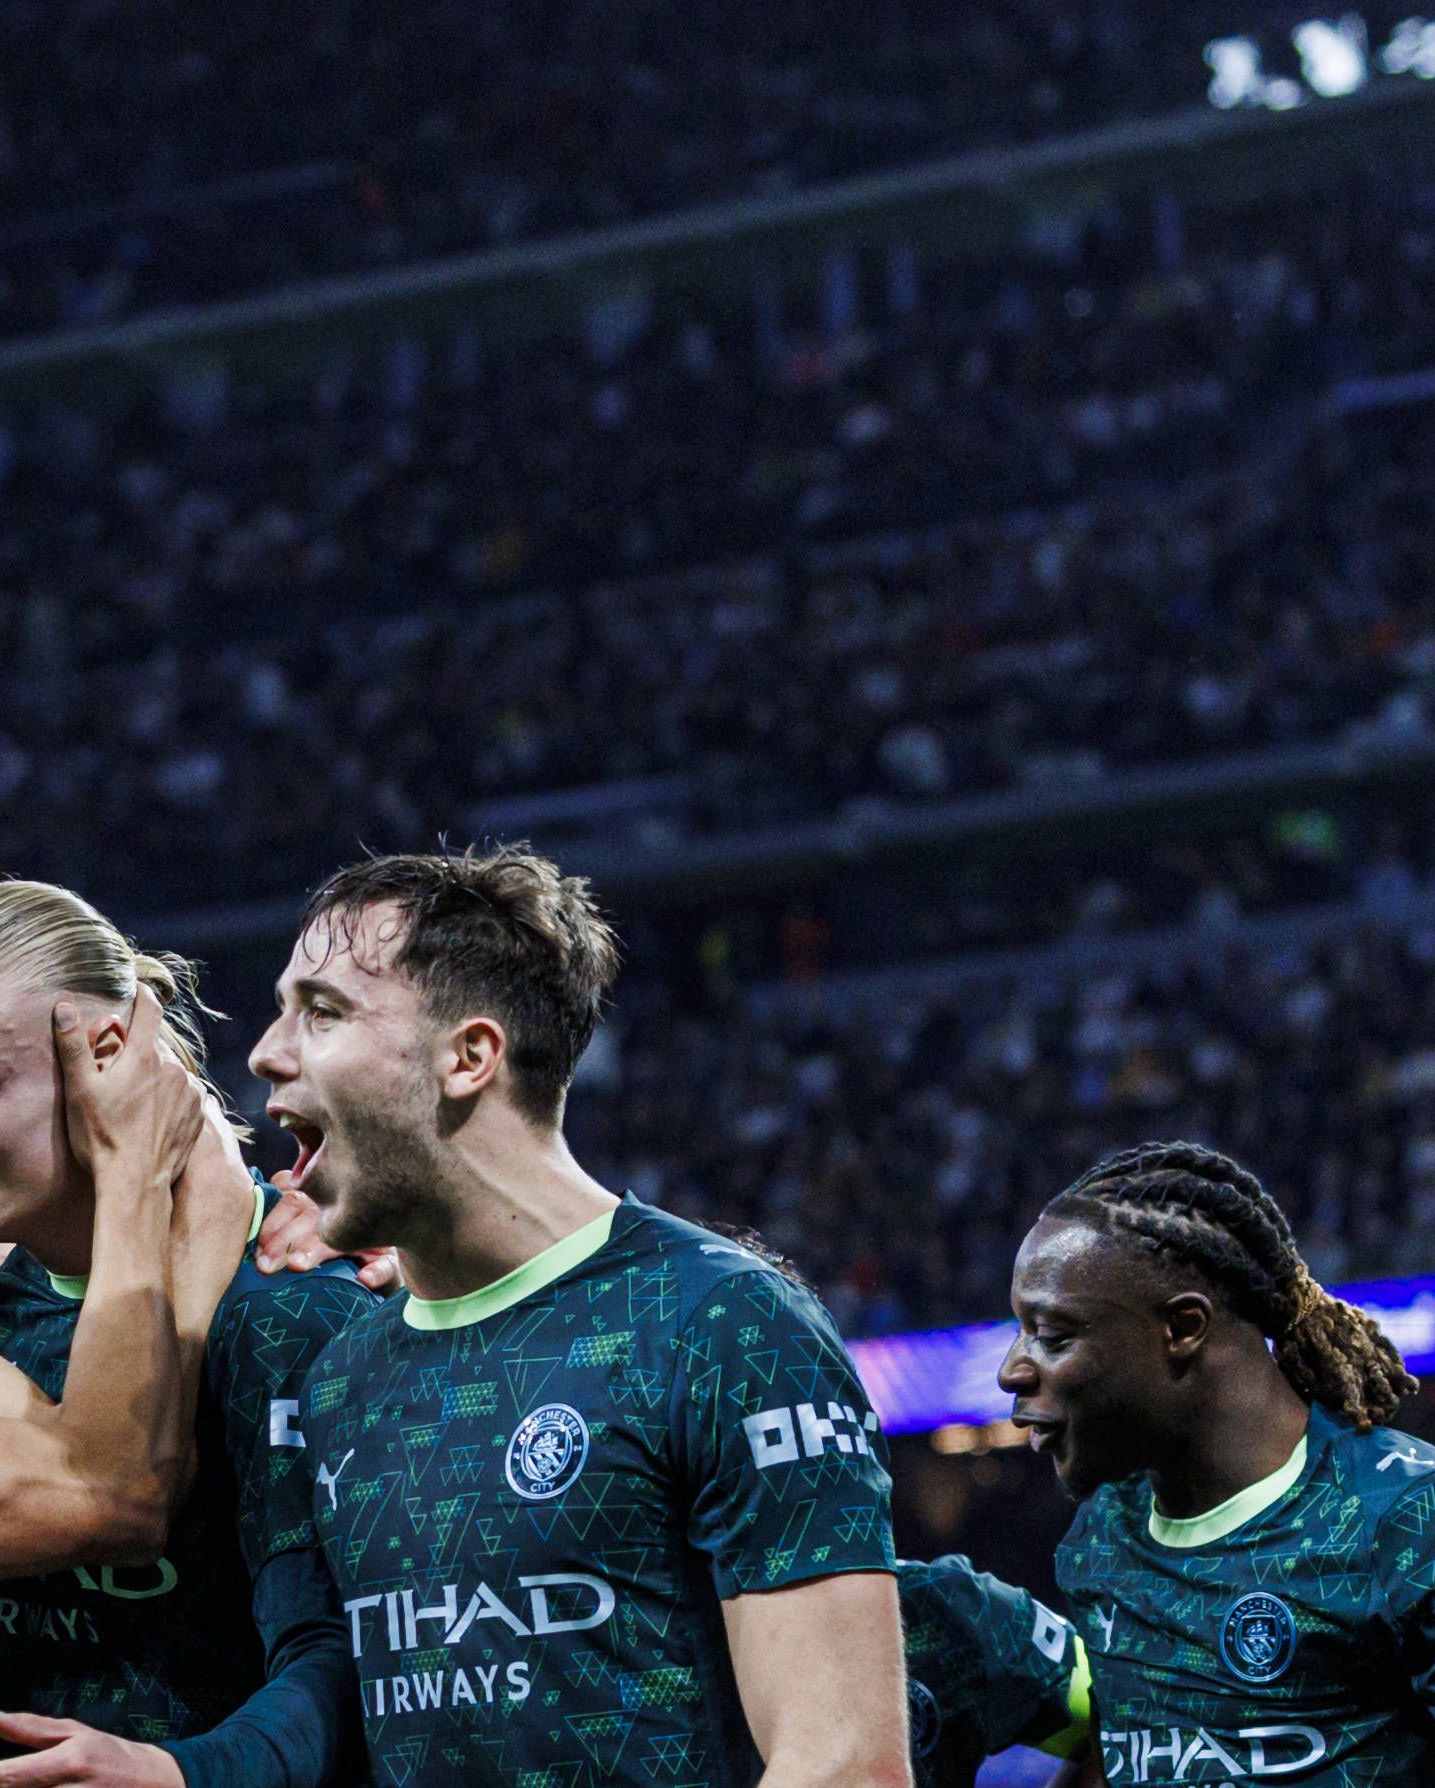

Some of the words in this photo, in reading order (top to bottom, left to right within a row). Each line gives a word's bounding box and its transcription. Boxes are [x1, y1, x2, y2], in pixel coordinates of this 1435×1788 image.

[529, 1481, 556, 1493] CITY
[344, 1573, 616, 1659] TIHAD
[361, 1661, 531, 1718] IRWAYS
[1101, 1725, 1326, 1782] TIHAD
